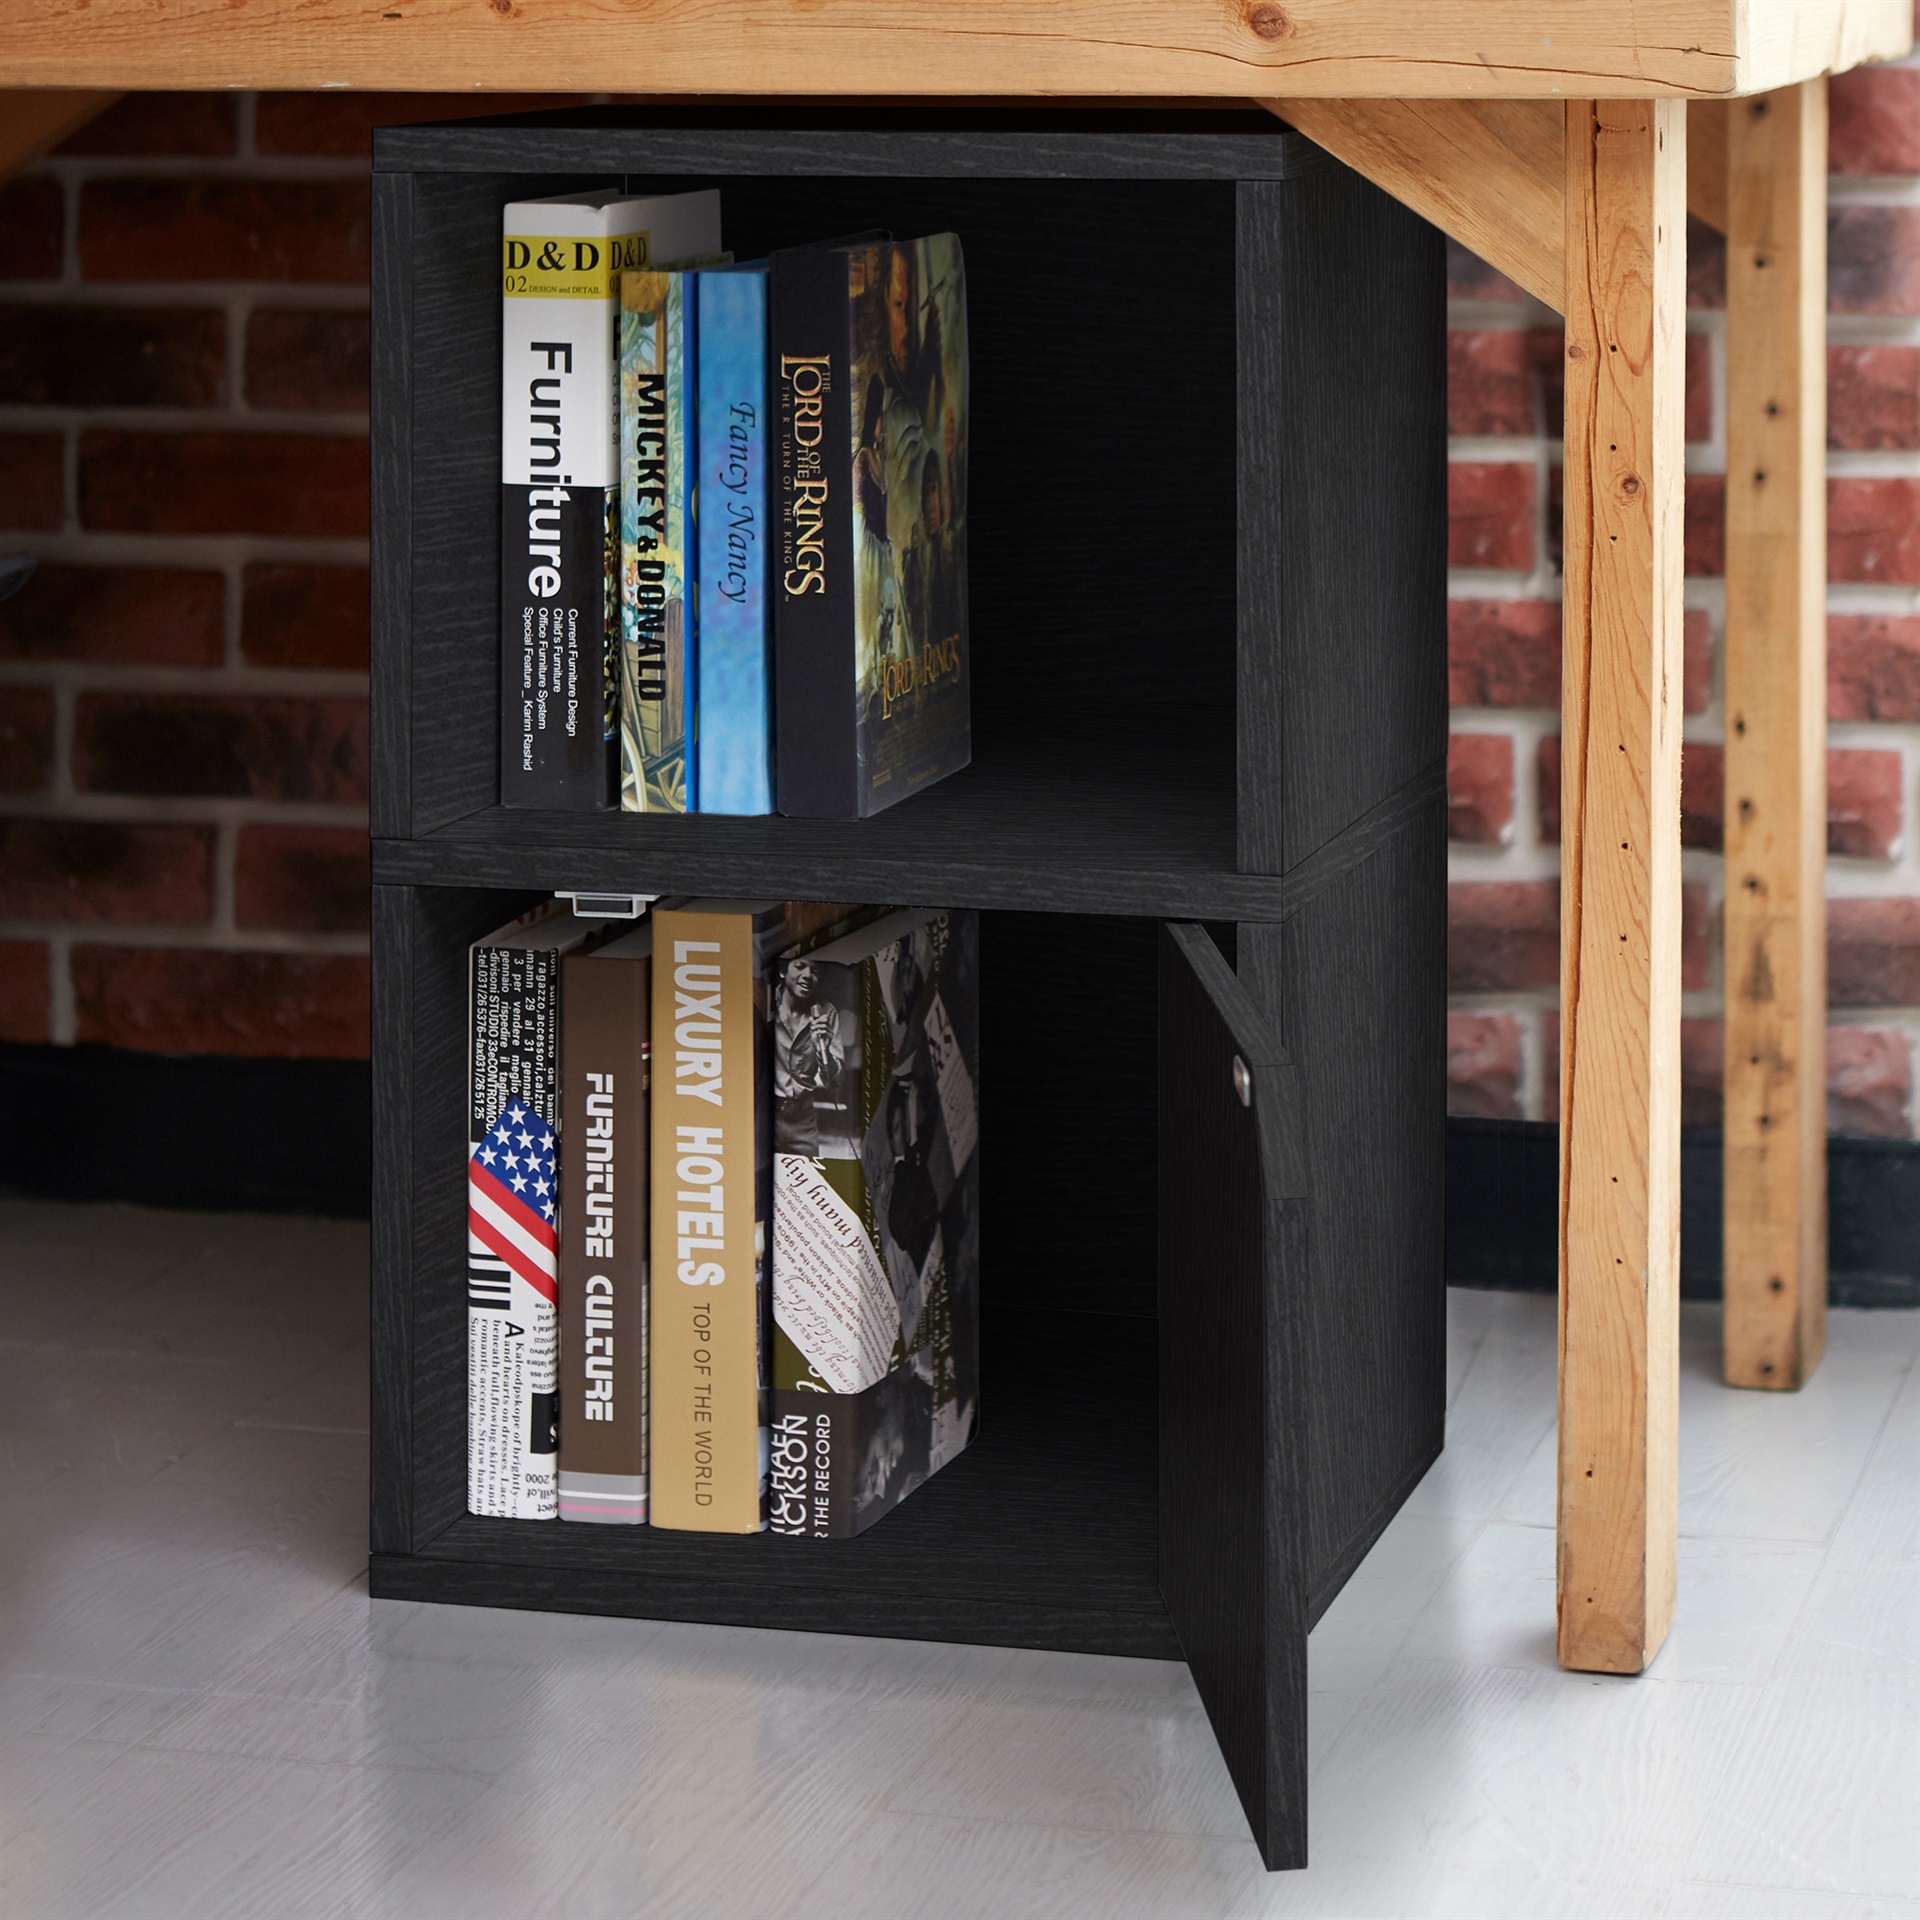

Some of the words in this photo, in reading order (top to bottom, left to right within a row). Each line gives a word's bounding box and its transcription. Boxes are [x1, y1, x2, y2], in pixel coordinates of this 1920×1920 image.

[506, 241, 530, 270] D
[572, 242, 599, 271] D
[505, 275, 527, 293] 02
[528, 285, 557, 293] DESIGN
[559, 286, 570, 294] and
[572, 286, 601, 294] DETAIL
[782, 386, 790, 409] THE
[822, 371, 831, 393] THE
[781, 353, 830, 448] LORD
[636, 374, 665, 534] MICKEY
[719, 402, 756, 495] Fancy
[797, 447, 810, 479] THE
[809, 452, 821, 475] OF
[528, 341, 573, 598] Furniture
[783, 476, 791, 492] OF
[783, 499, 792, 523] THE
[637, 535, 658, 553] &
[783, 531, 792, 564] KING
[784, 476, 828, 596] RINGS
[718, 502, 755, 604] Nancy
[522, 607, 534, 646] Special
[538, 607, 548, 639] Office
[553, 608, 563, 644] Child's
[568, 608, 578, 648] Current
[637, 560, 666, 701] DONALD
[523, 648, 534, 689] Feature
[538, 641, 548, 688] Furniture
[553, 646, 563, 693] Furniture
[568, 650, 579, 698] Furniture
[523, 700, 533, 732] Karim
[536, 690, 548, 730] System
[566, 700, 578, 737] Design
[523, 733, 533, 771] Rashid
[500, 950, 512, 993] gennaio
[514, 957, 524, 965] 3
[512, 973, 522, 993] per
[488, 995, 500, 1038] STUDIO
[525, 997, 535, 1011] 29
[499, 1001, 511, 1048] rispedire
[511, 1001, 523, 1046] vendere
[524, 1020, 535, 1030] al
[674, 940, 722, 1107] LUXURY
[524, 1039, 534, 1052] 31
[509, 1055, 521, 1094] meglio
[781, 1156, 809, 1188] hip
[676, 1125, 725, 1287] HOTELS
[785, 1184, 803, 1205] vocal
[786, 1199, 797, 1212] the
[800, 1203, 815, 1218] and
[807, 1184, 852, 1237] many
[803, 1220, 819, 1237] such
[812, 1217, 833, 1239] sound
[781, 1249, 796, 1264] and
[798, 1252, 810, 1266] the
[808, 1245, 835, 1276] Jackson
[830, 1238, 855, 1265] musical
[810, 1264, 818, 1274] in
[815, 1273, 832, 1291] MTV
[831, 1289, 841, 1300] on
[505, 1321, 525, 1338] A
[693, 1303, 710, 1342] TOP
[481, 1319, 489, 1375] romantic
[492, 1320, 501, 1369] beneath
[504, 1340, 512, 1364] and
[693, 1349, 711, 1376] OF
[503, 1366, 512, 1405] hearts
[501, 1408, 509, 1423] on
[694, 1384, 712, 1422] THE
[479, 1429, 487, 1466] Straw
[513, 1432, 522, 1445] of
[815, 1414, 830, 1491] RECORD
[490, 1445, 498, 1481] skirts
[525, 1473, 550, 1485] 2000
[694, 1430, 712, 1507] WORLD
[478, 1468, 486, 1496] hats
[500, 1477, 509, 1507] Lace
[814, 1497, 829, 1526] THE
